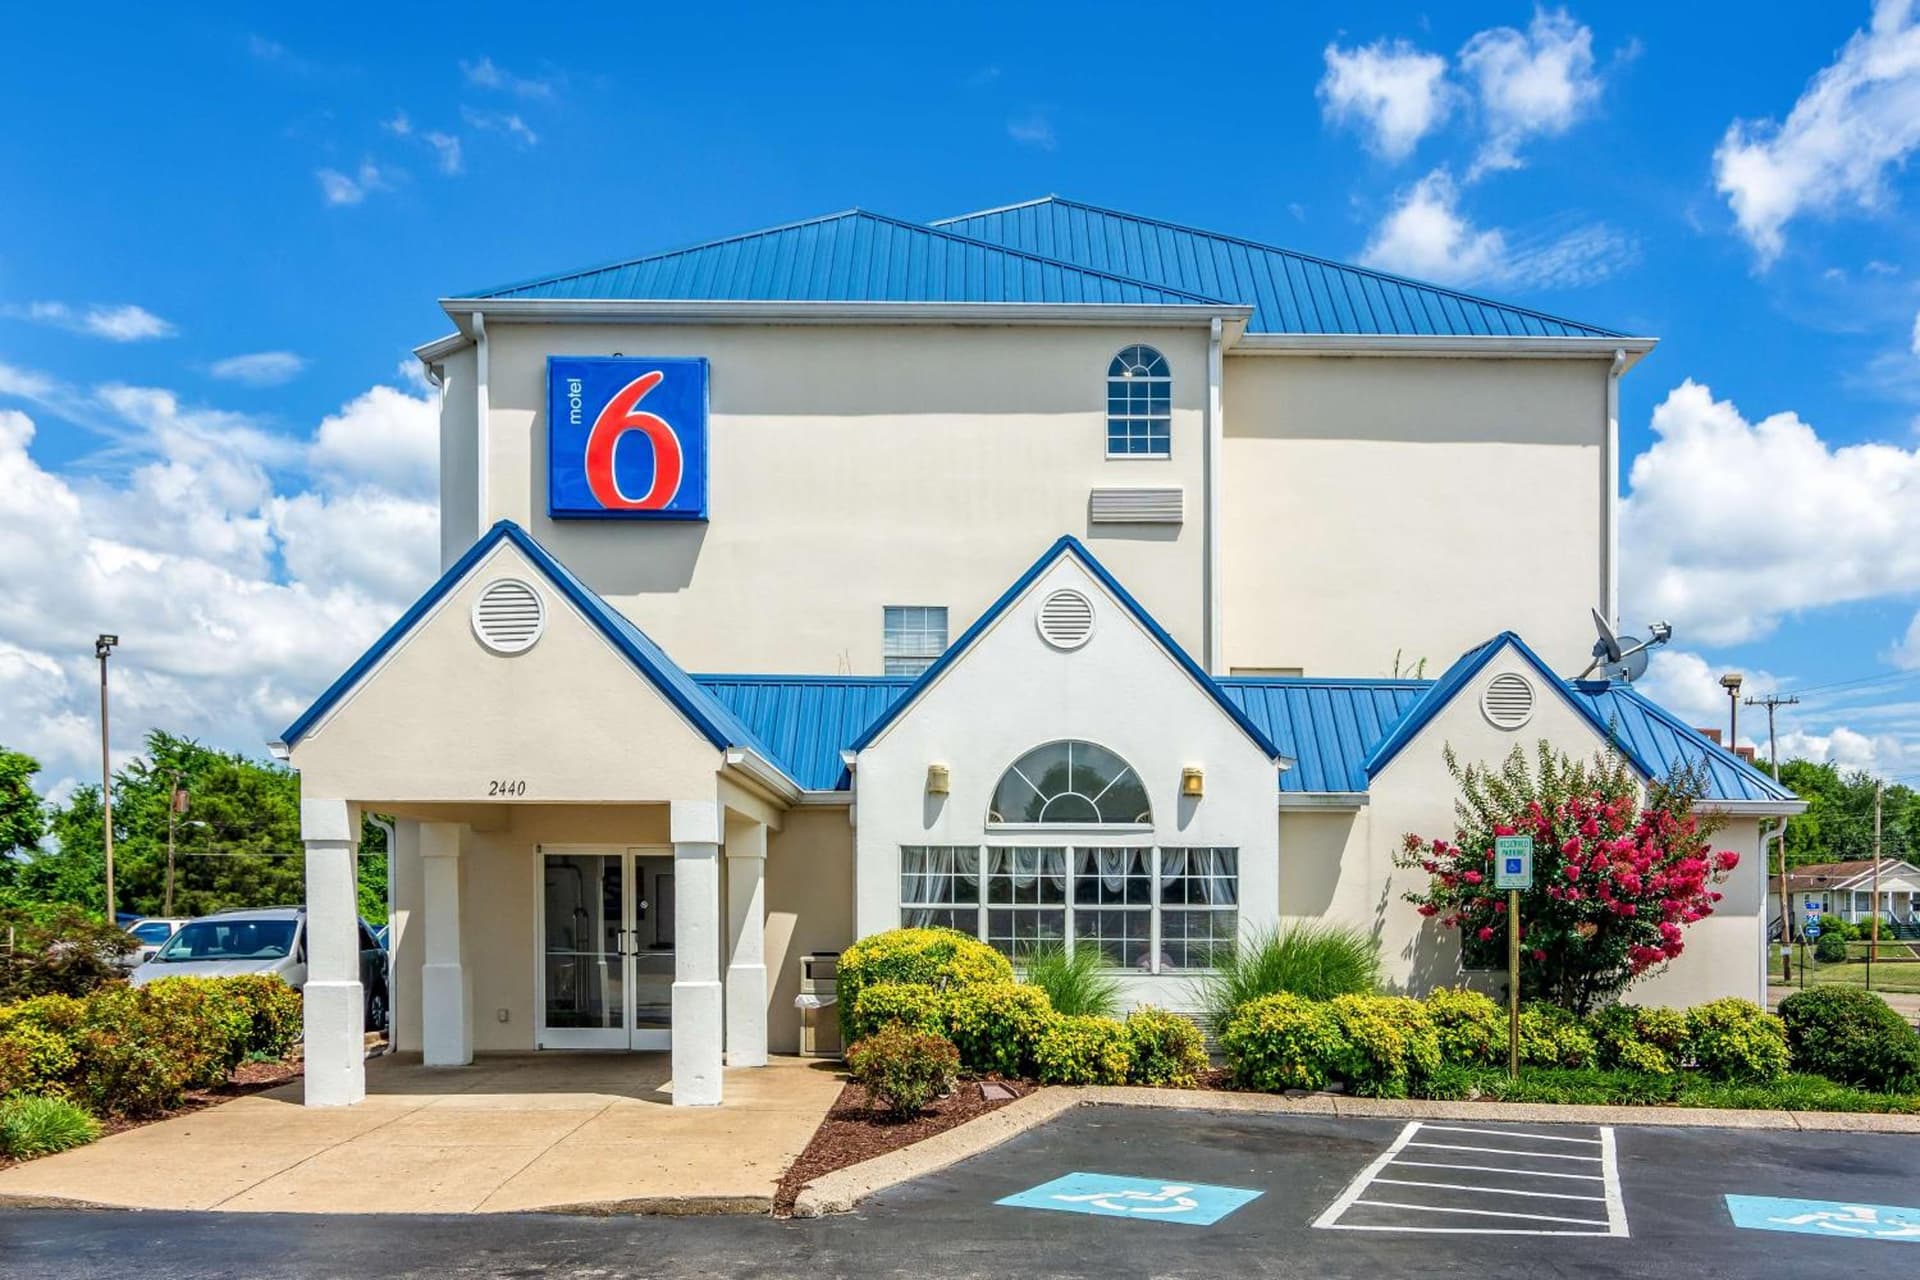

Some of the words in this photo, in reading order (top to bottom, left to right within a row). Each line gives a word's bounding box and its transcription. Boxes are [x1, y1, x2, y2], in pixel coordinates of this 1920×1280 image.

[567, 378, 582, 425] motel
[585, 370, 684, 510] 6
[488, 780, 526, 796] 2440
